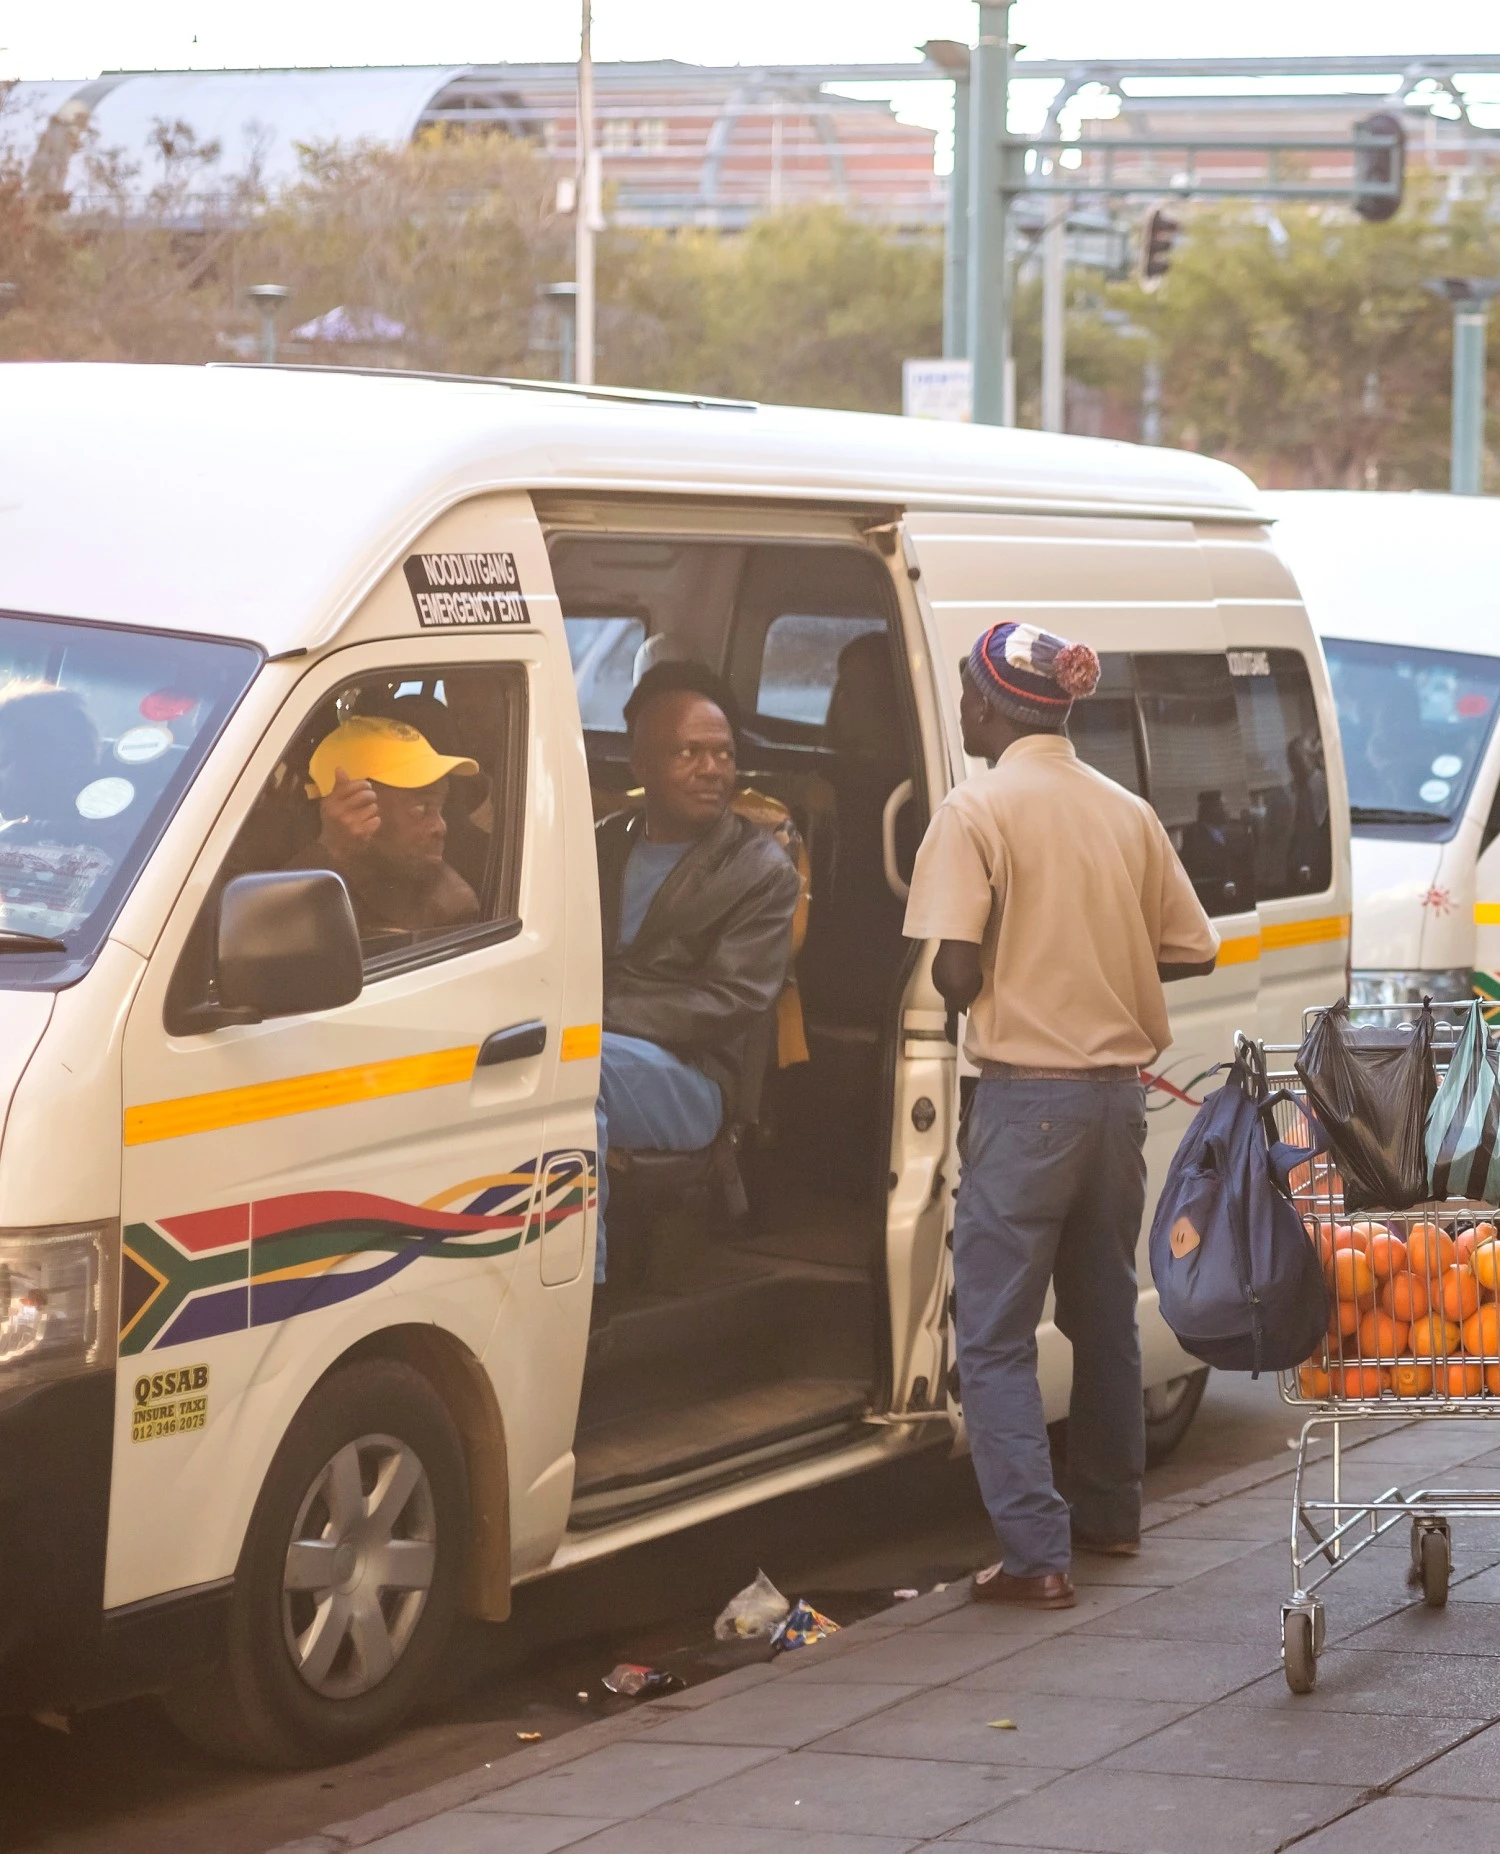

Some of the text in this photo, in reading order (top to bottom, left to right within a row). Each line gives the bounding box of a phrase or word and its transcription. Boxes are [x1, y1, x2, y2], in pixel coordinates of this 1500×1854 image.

[421, 553, 515, 585] NOODUITGANG
[416, 590, 524, 624] EMERGENCY EXIT
[135, 1366, 208, 1406] QSSAB
[132, 1414, 205, 1440] 012 346 2075
[133, 1398, 207, 1424] INSURE TAXI
